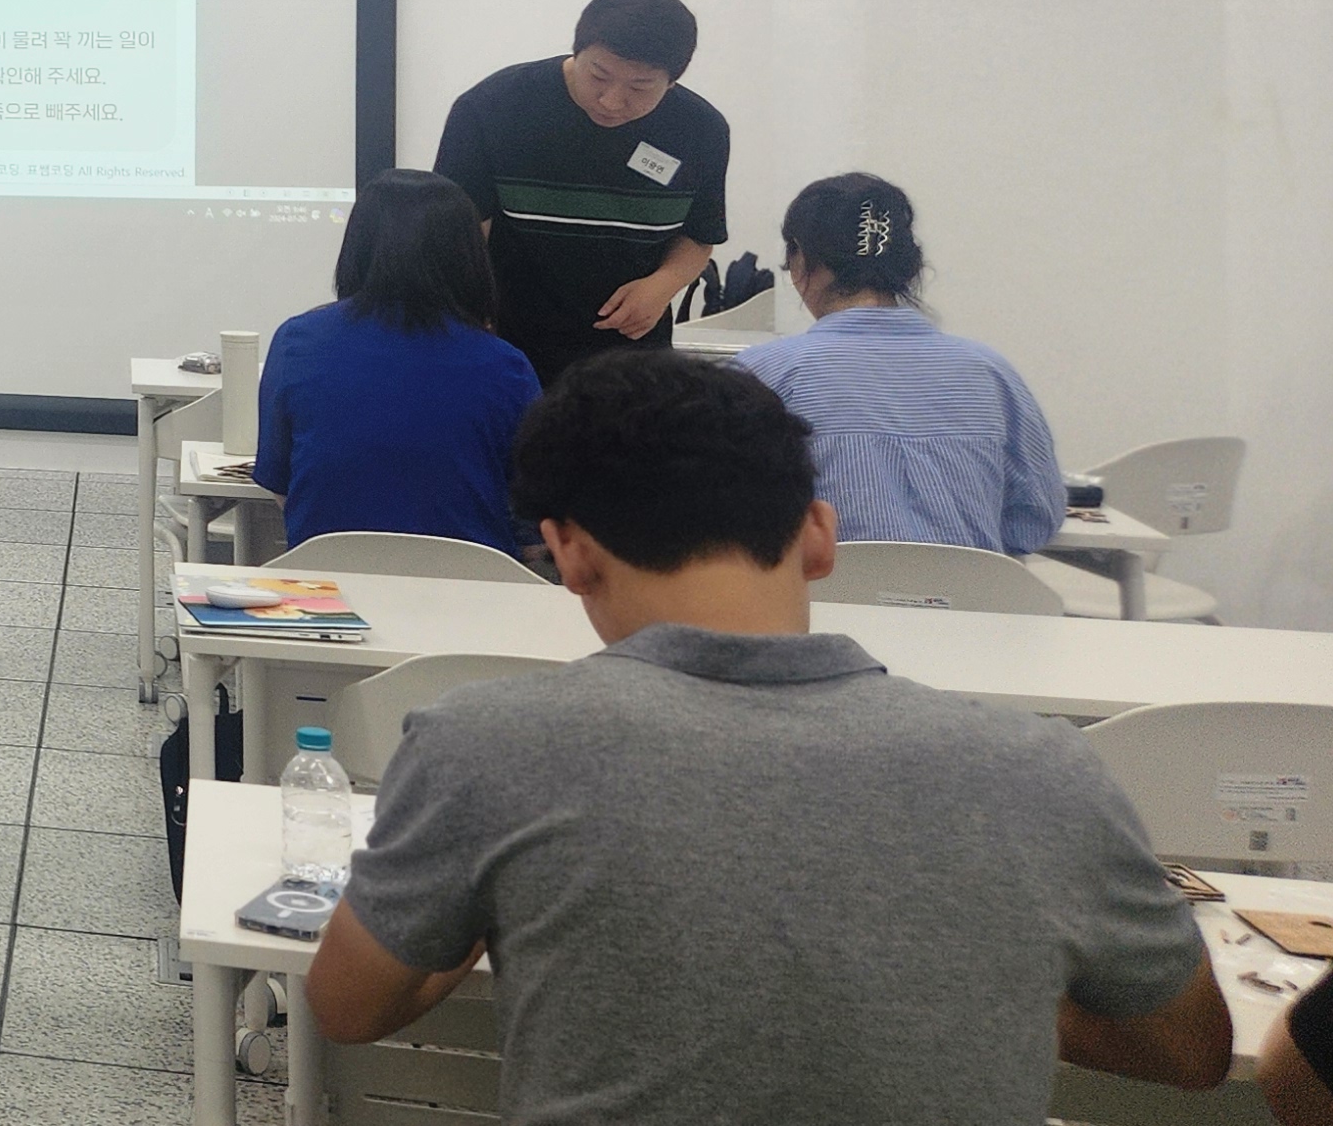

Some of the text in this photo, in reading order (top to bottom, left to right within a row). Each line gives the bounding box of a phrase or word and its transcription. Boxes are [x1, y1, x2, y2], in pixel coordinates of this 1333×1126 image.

[12, 30, 48, 49] 물려
[53, 31, 72, 49] 꽉
[77, 30, 113, 49] 끼는
[118, 30, 156, 49] 일이
[47, 67, 106, 85] 주세요.
[46, 102, 124, 122] 빼주세요.
[78, 165, 93, 177] All
[96, 166, 131, 179] Rights
